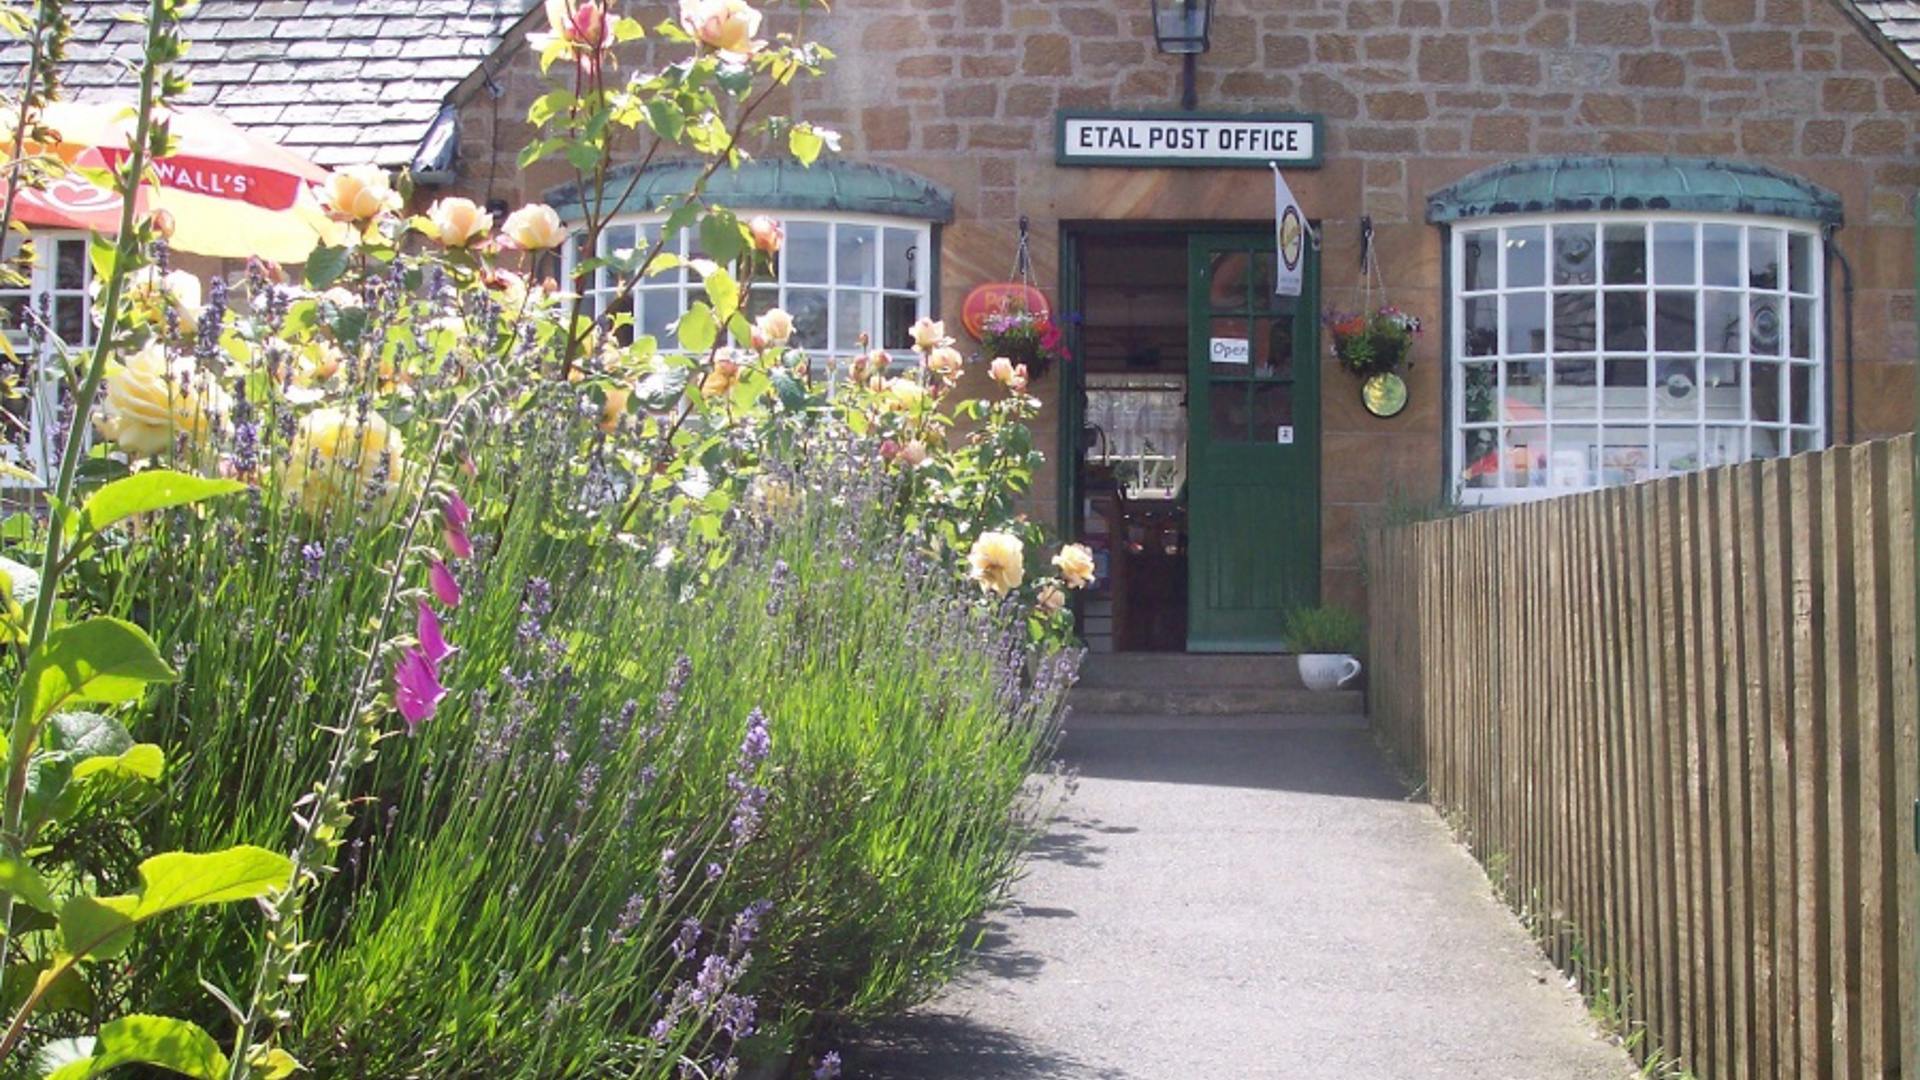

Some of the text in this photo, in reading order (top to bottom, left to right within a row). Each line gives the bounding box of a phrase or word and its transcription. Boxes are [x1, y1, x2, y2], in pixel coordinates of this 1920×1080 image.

[1080, 126, 1299, 151] ETAL POST OFFICE
[152, 161, 247, 193] WALL'S
